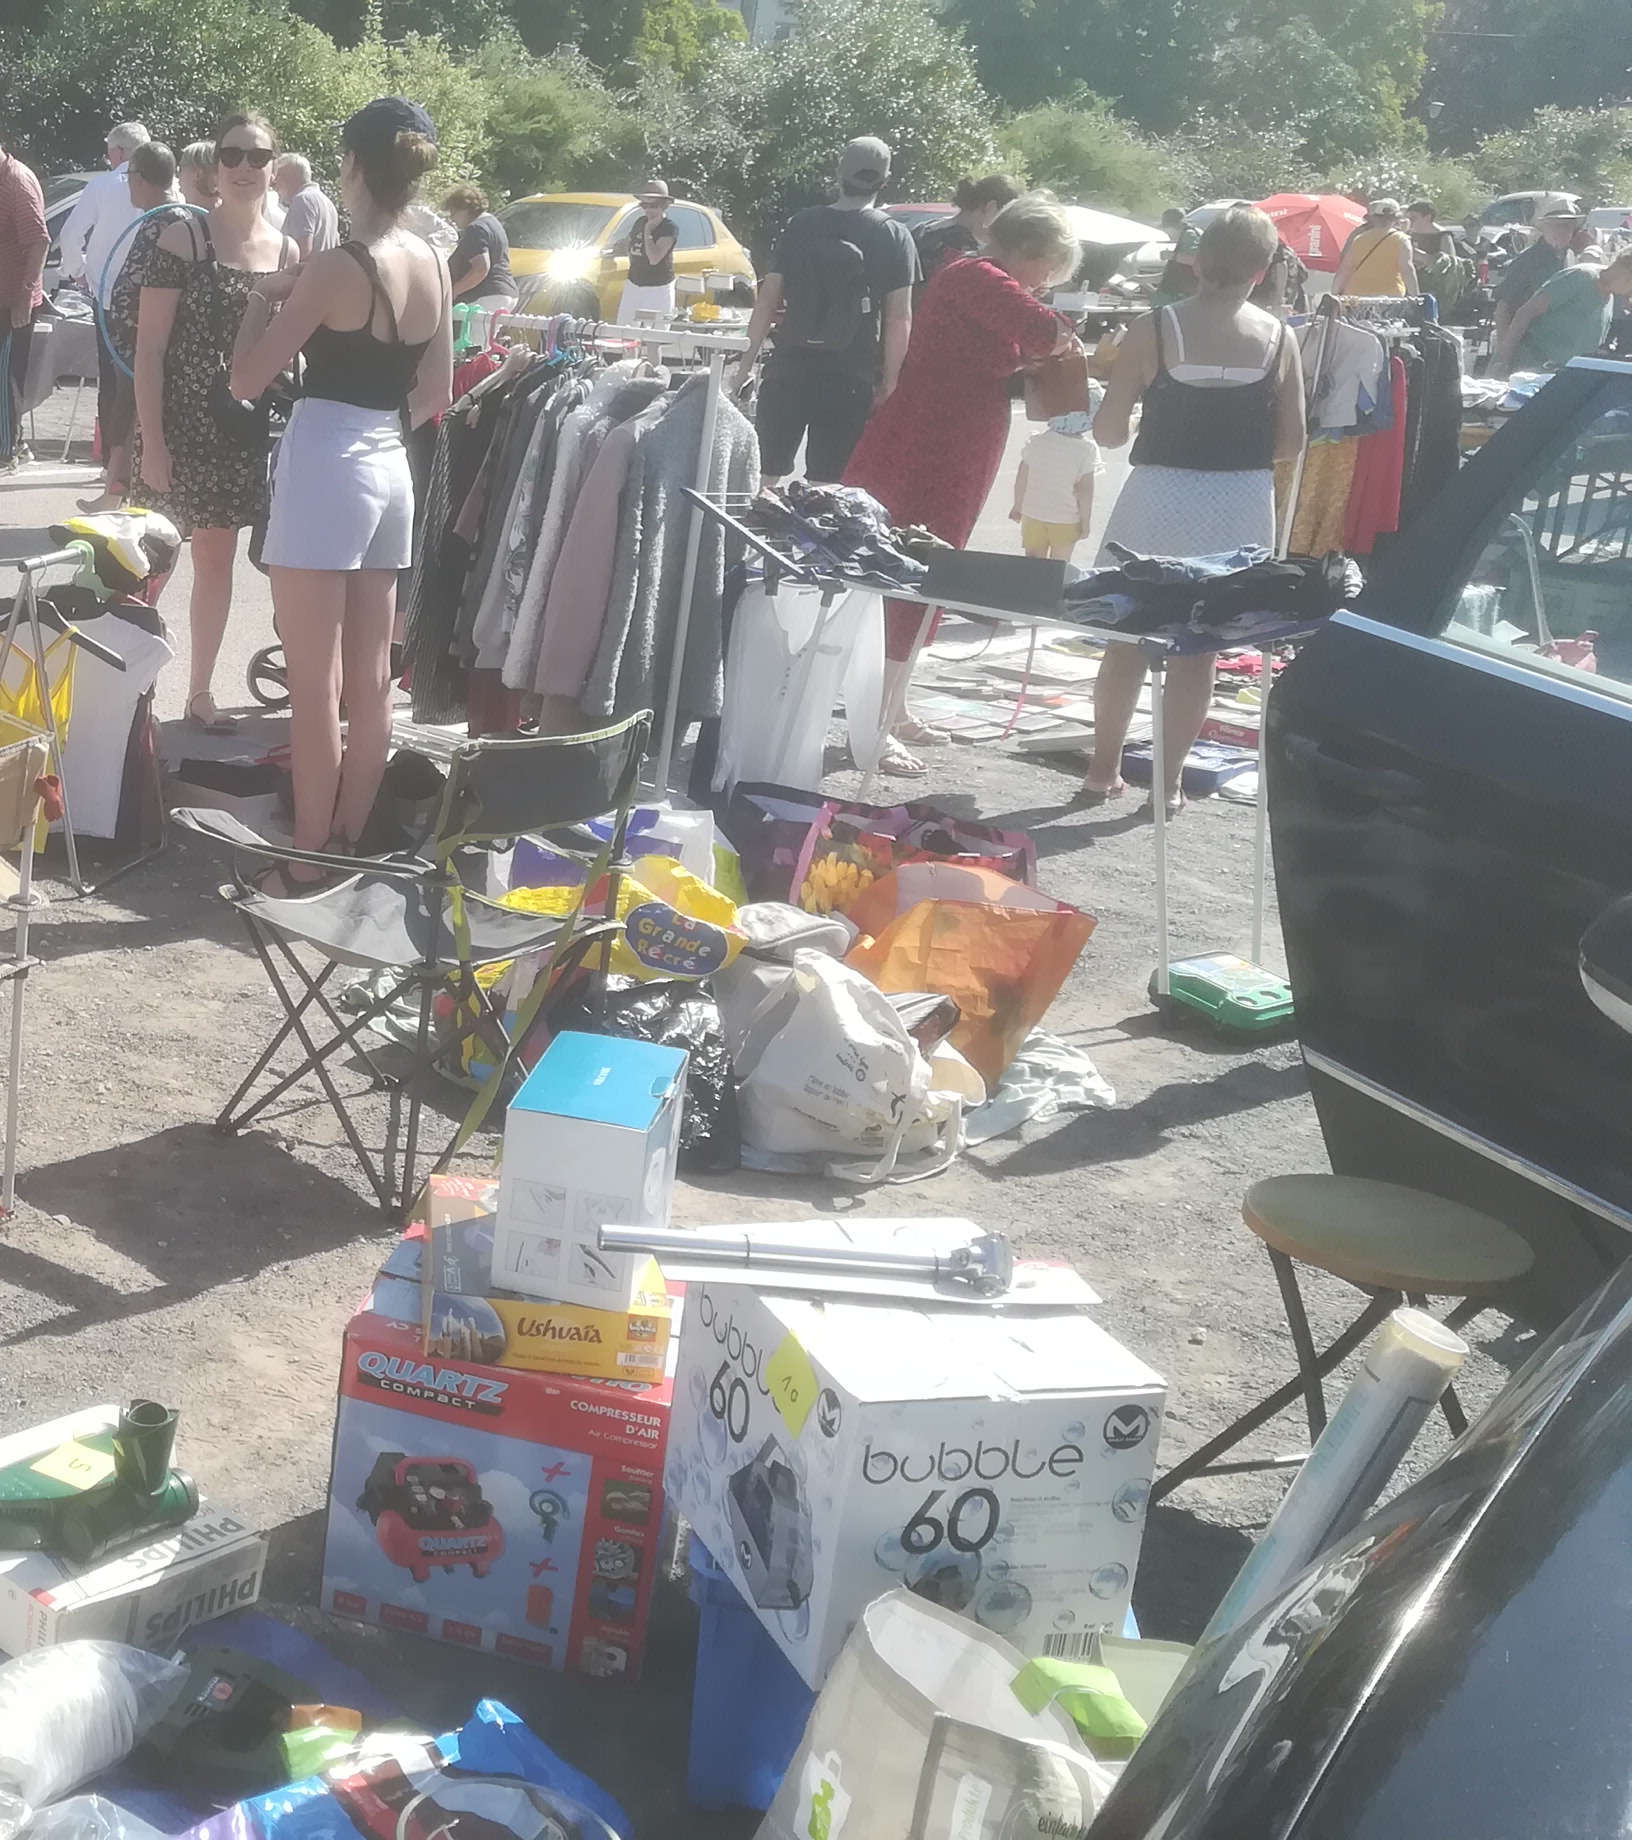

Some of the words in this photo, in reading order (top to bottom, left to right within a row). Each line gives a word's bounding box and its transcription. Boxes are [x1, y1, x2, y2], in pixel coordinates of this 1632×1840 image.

[638, 917, 711, 957] Grande
[671, 913, 697, 931] La
[637, 938, 697, 970] Récré
[517, 1316, 603, 1344] Ushuaïa
[699, 1283, 781, 1414] bubbl
[358, 1351, 509, 1404] QUARTZ
[570, 1399, 662, 1428] COMPRESSEUR
[709, 1360, 750, 1443] 60
[588, 1429, 602, 1439] Air
[603, 1432, 658, 1450] Compressor
[624, 1424, 660, 1440] D'AIR
[862, 1439, 1084, 1484] bubble
[900, 1488, 1000, 1555] 60
[123, 1516, 247, 1570] PHILIPS
[145, 1571, 258, 1640] PHILIPS
[37, 1610, 49, 1652] PHILI
